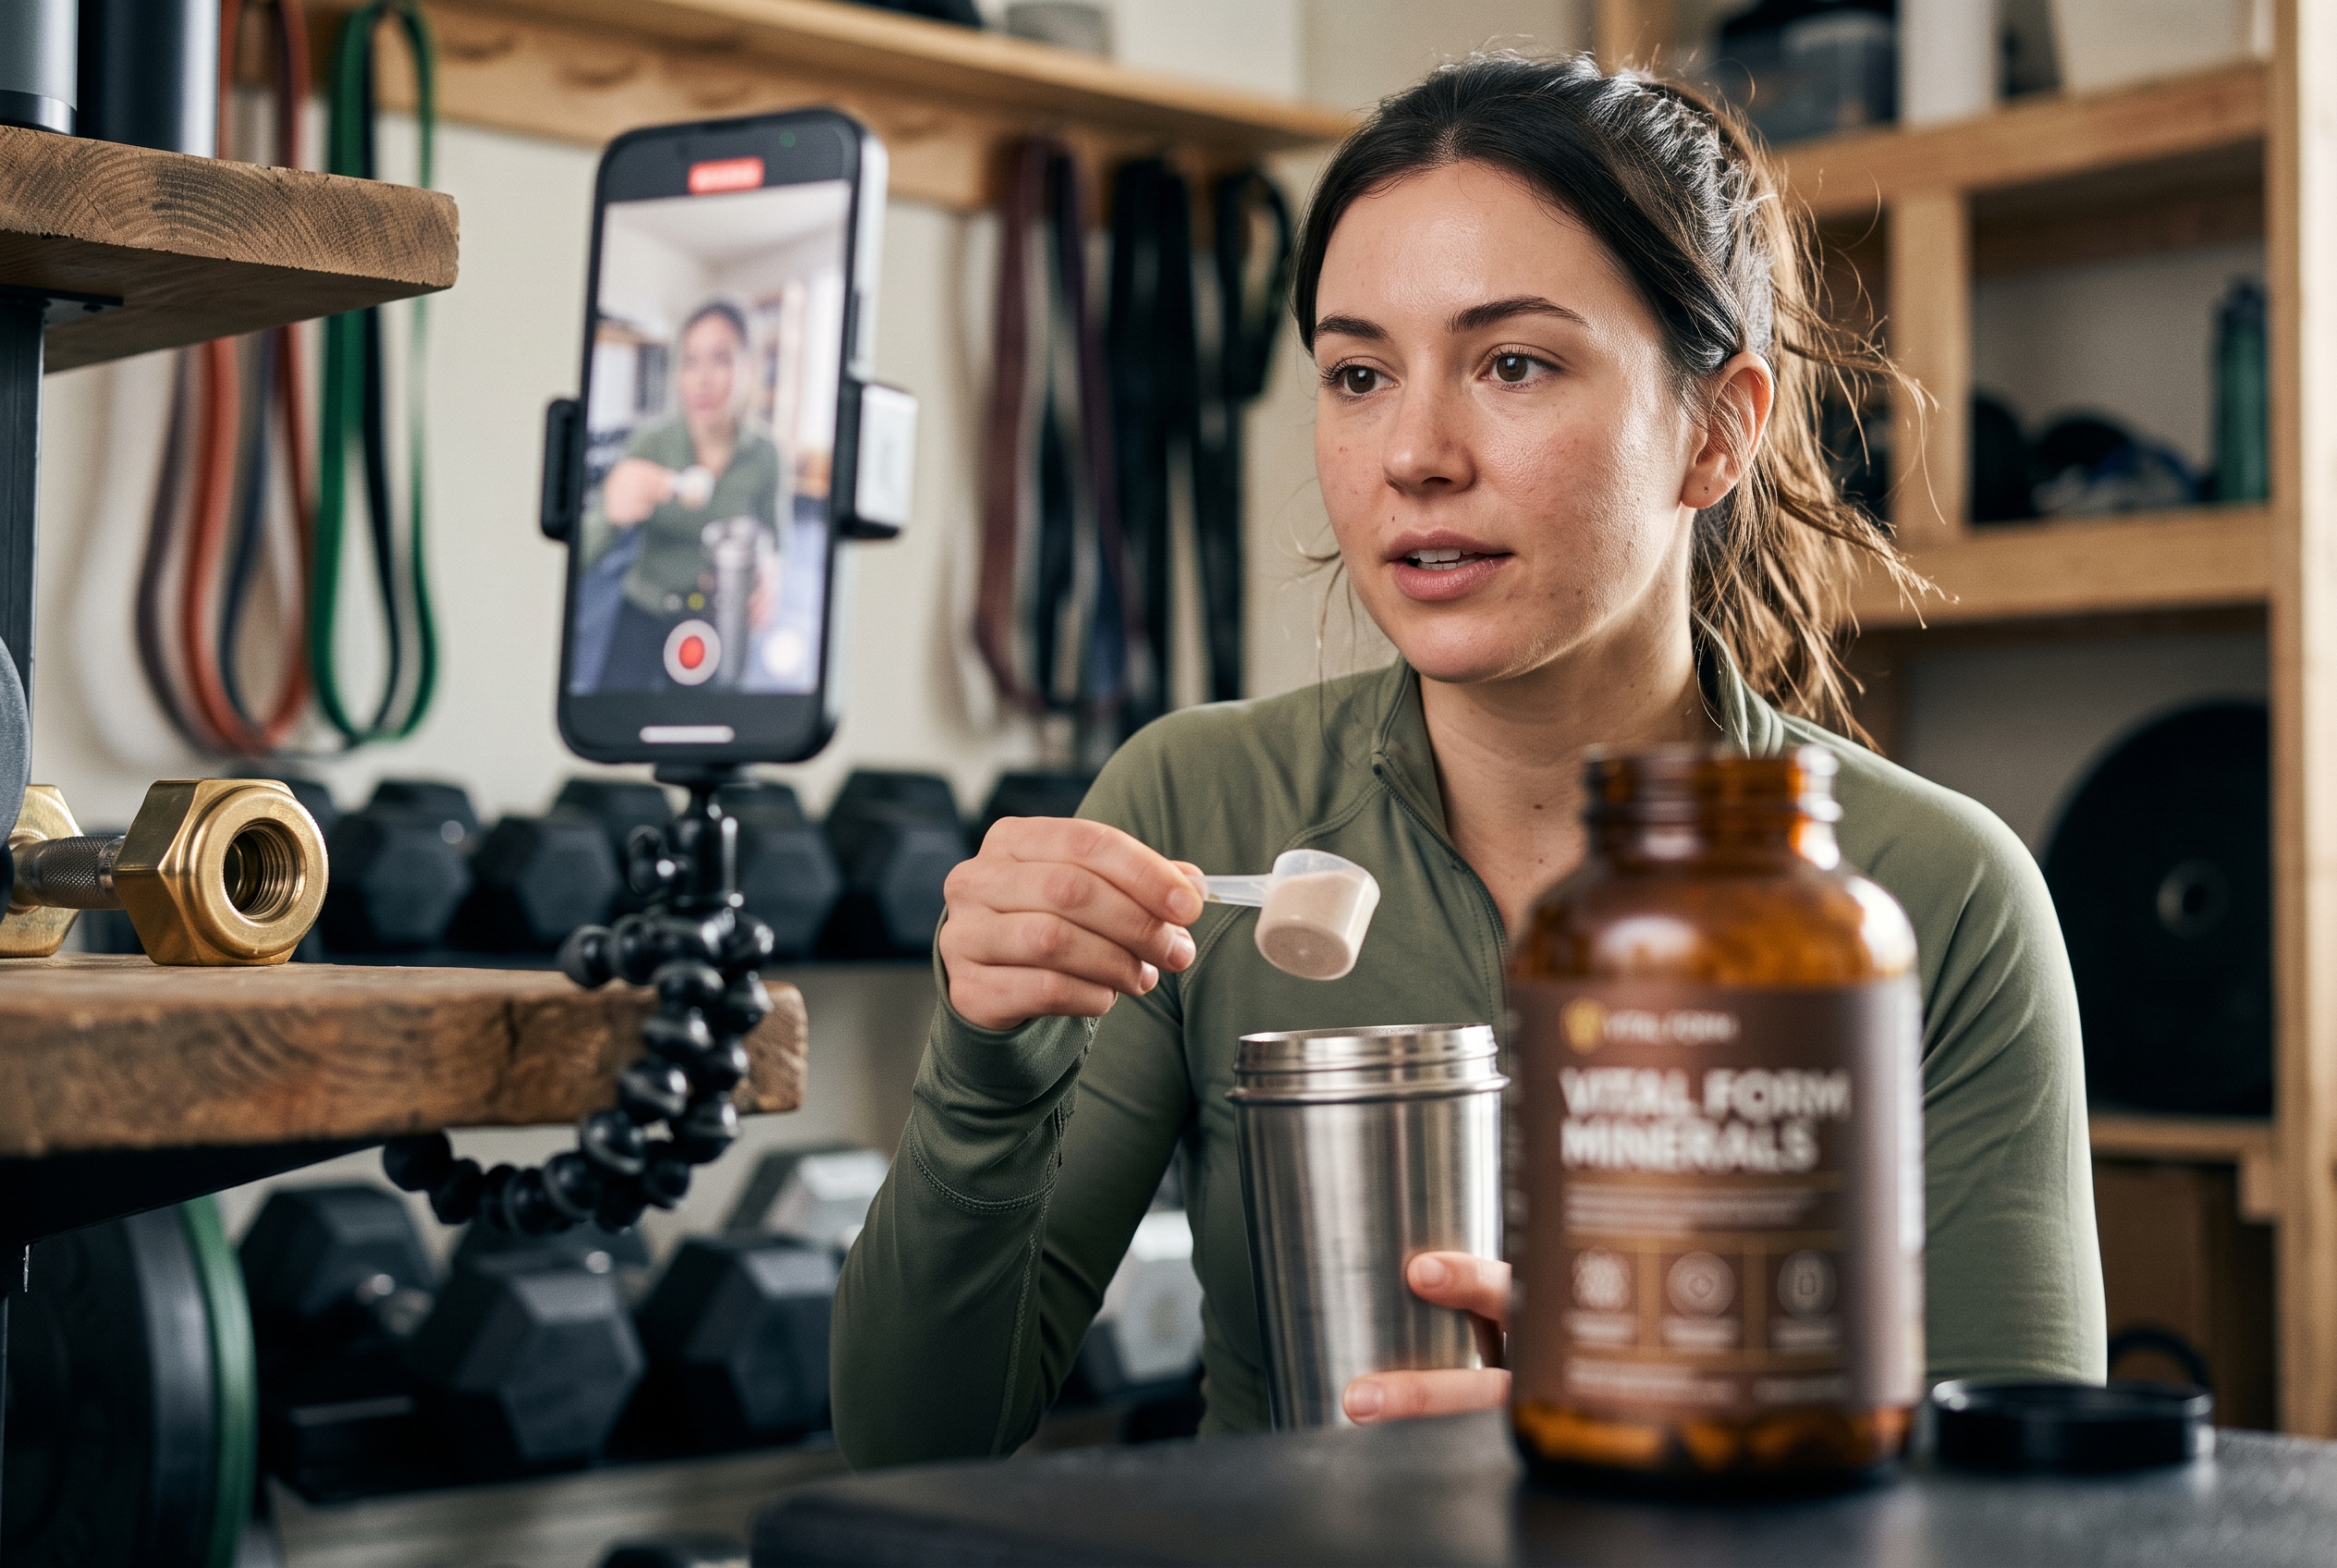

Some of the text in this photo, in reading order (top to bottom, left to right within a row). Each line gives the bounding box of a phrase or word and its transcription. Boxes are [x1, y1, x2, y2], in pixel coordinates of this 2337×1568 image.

[1560, 1068, 1852, 1121] VITAL FORM
[1561, 1118, 1819, 1171] MINERALS
